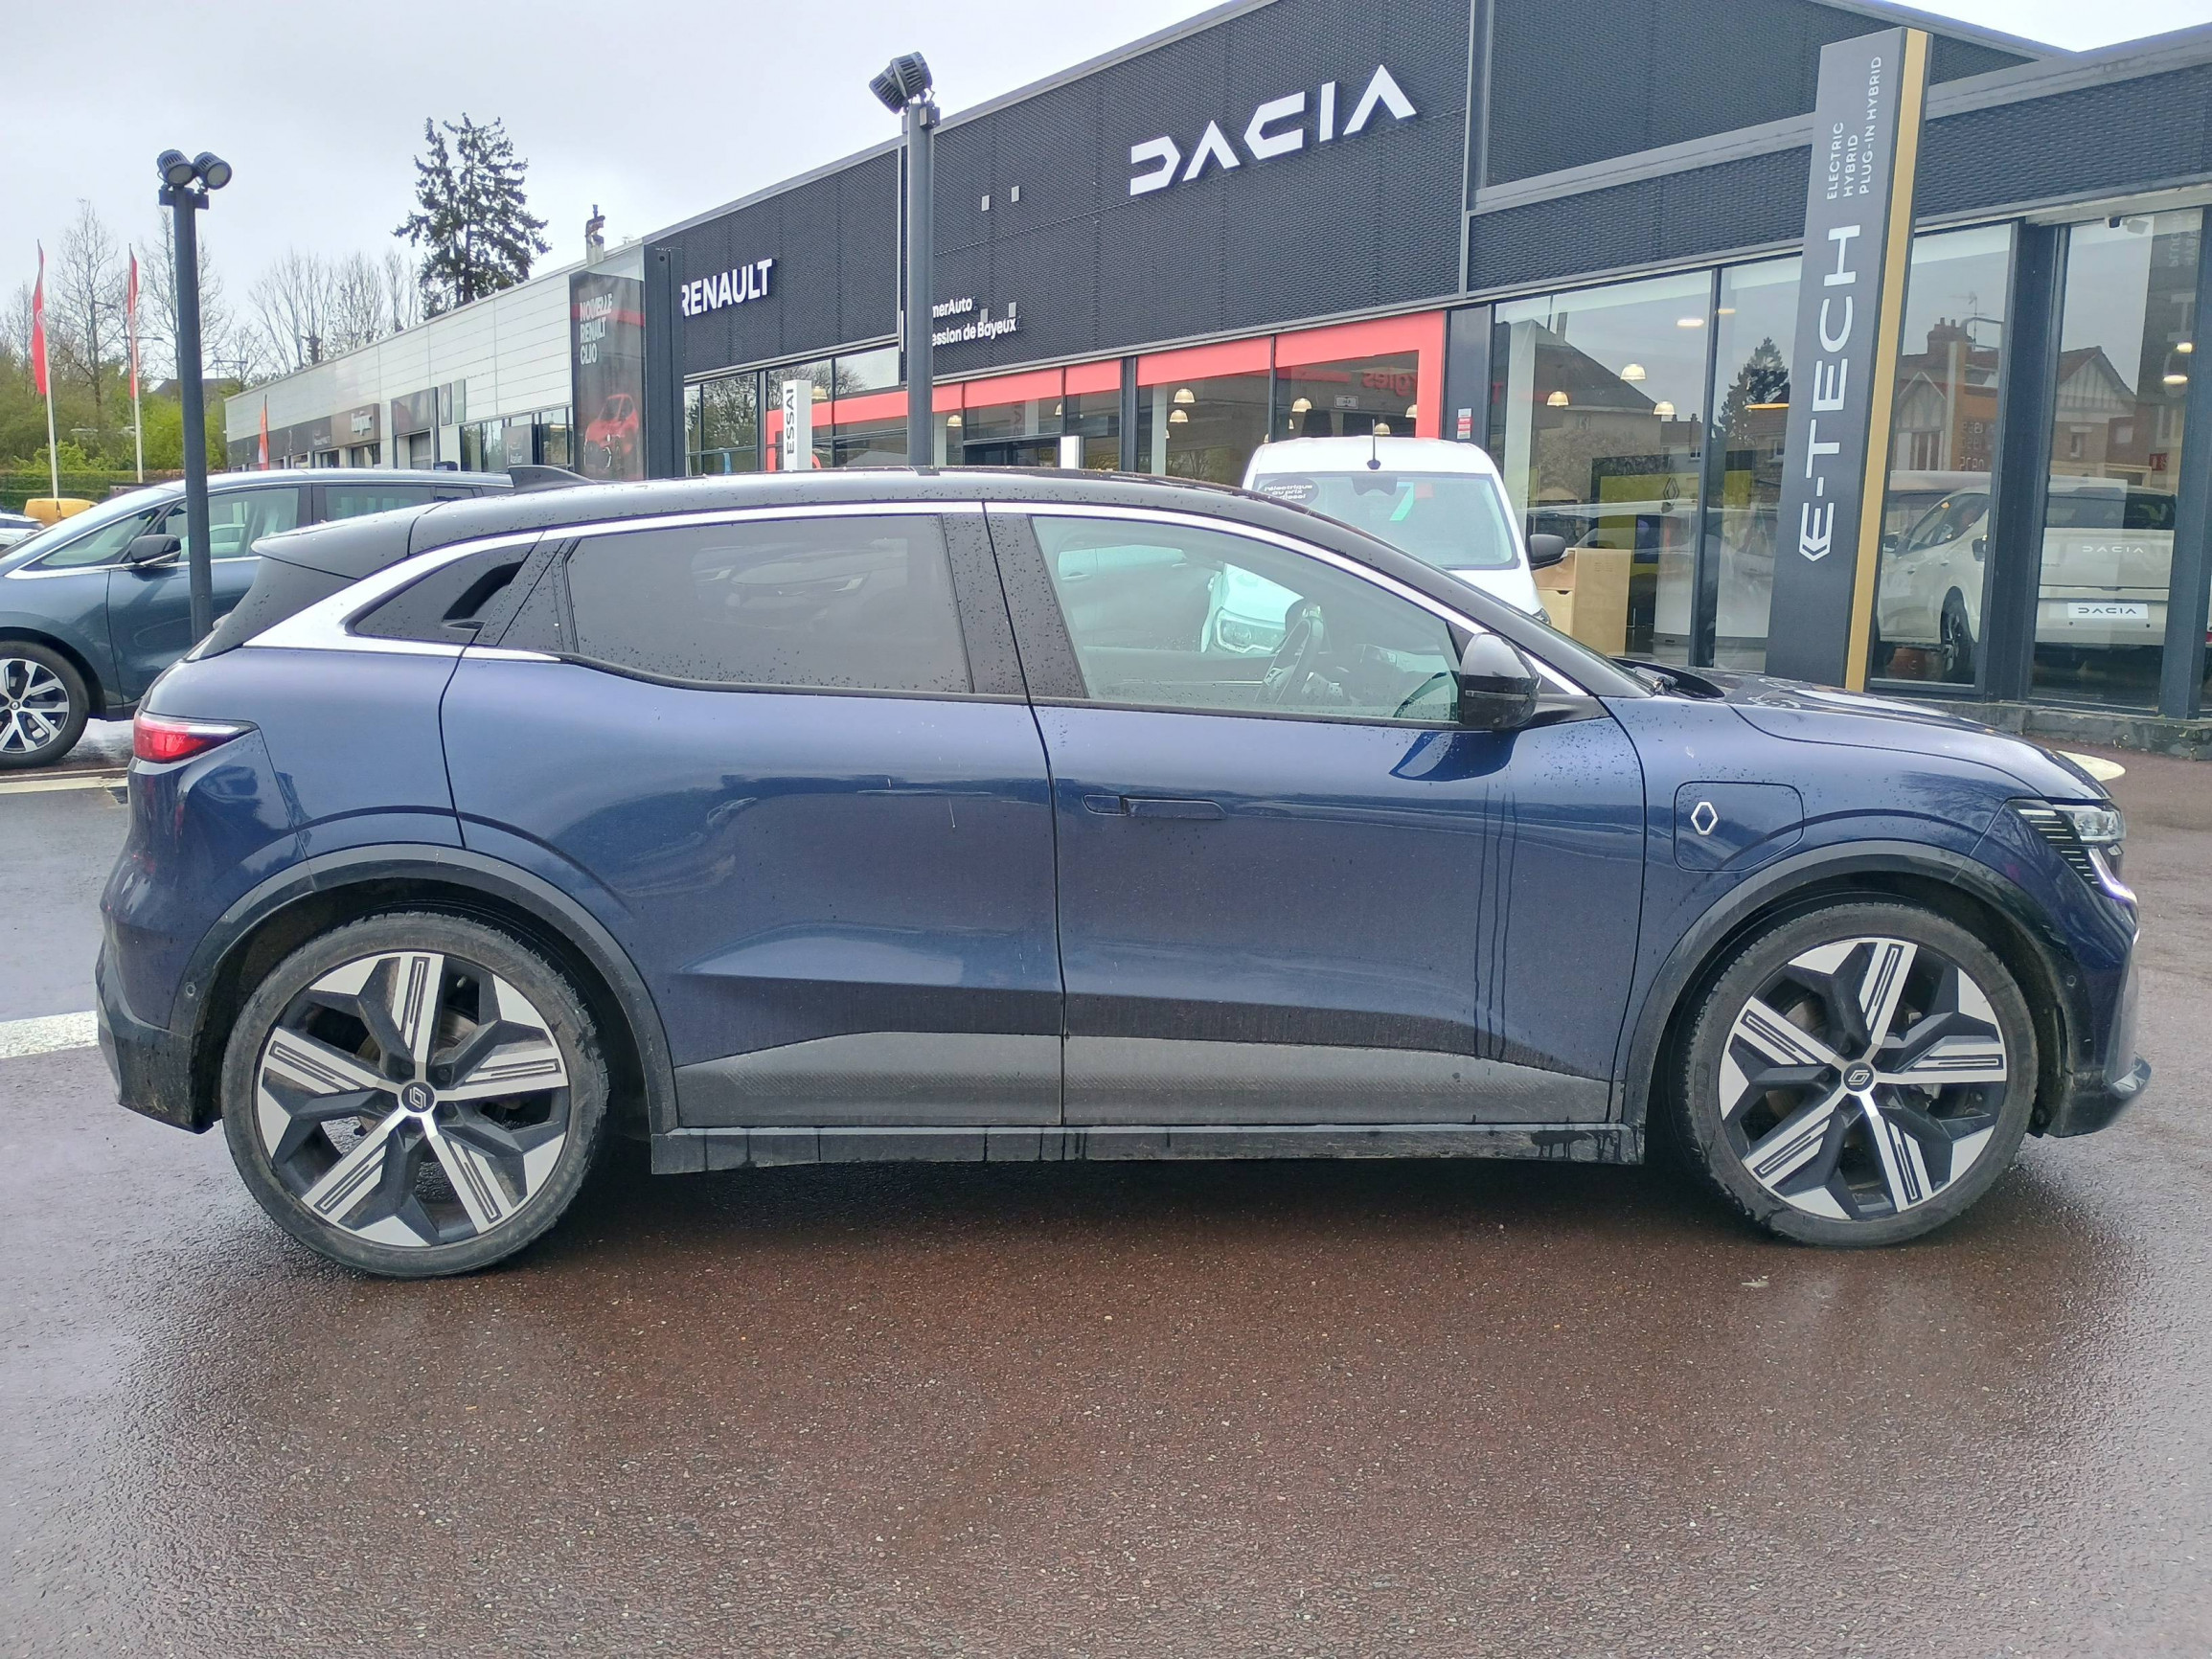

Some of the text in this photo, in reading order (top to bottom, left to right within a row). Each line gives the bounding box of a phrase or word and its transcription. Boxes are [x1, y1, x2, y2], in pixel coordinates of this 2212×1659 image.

[1130, 64, 1417, 196] DACIA
[1859, 57, 1881, 194] PLUG-IN HYBRID
[1827, 122, 1844, 200] ELECTRIC
[1843, 134, 1859, 197] HYBRID
[681, 258, 773, 317] RENAULT
[580, 343, 598, 365] CLIO
[963, 323, 976, 340] de
[977, 317, 1016, 340] Bayeux
[786, 388, 795, 455] ESSAI
[1798, 224, 1861, 562] E-TECH
[1285, 489, 1303, 497] prix
[2082, 545, 2144, 554] DACIA
